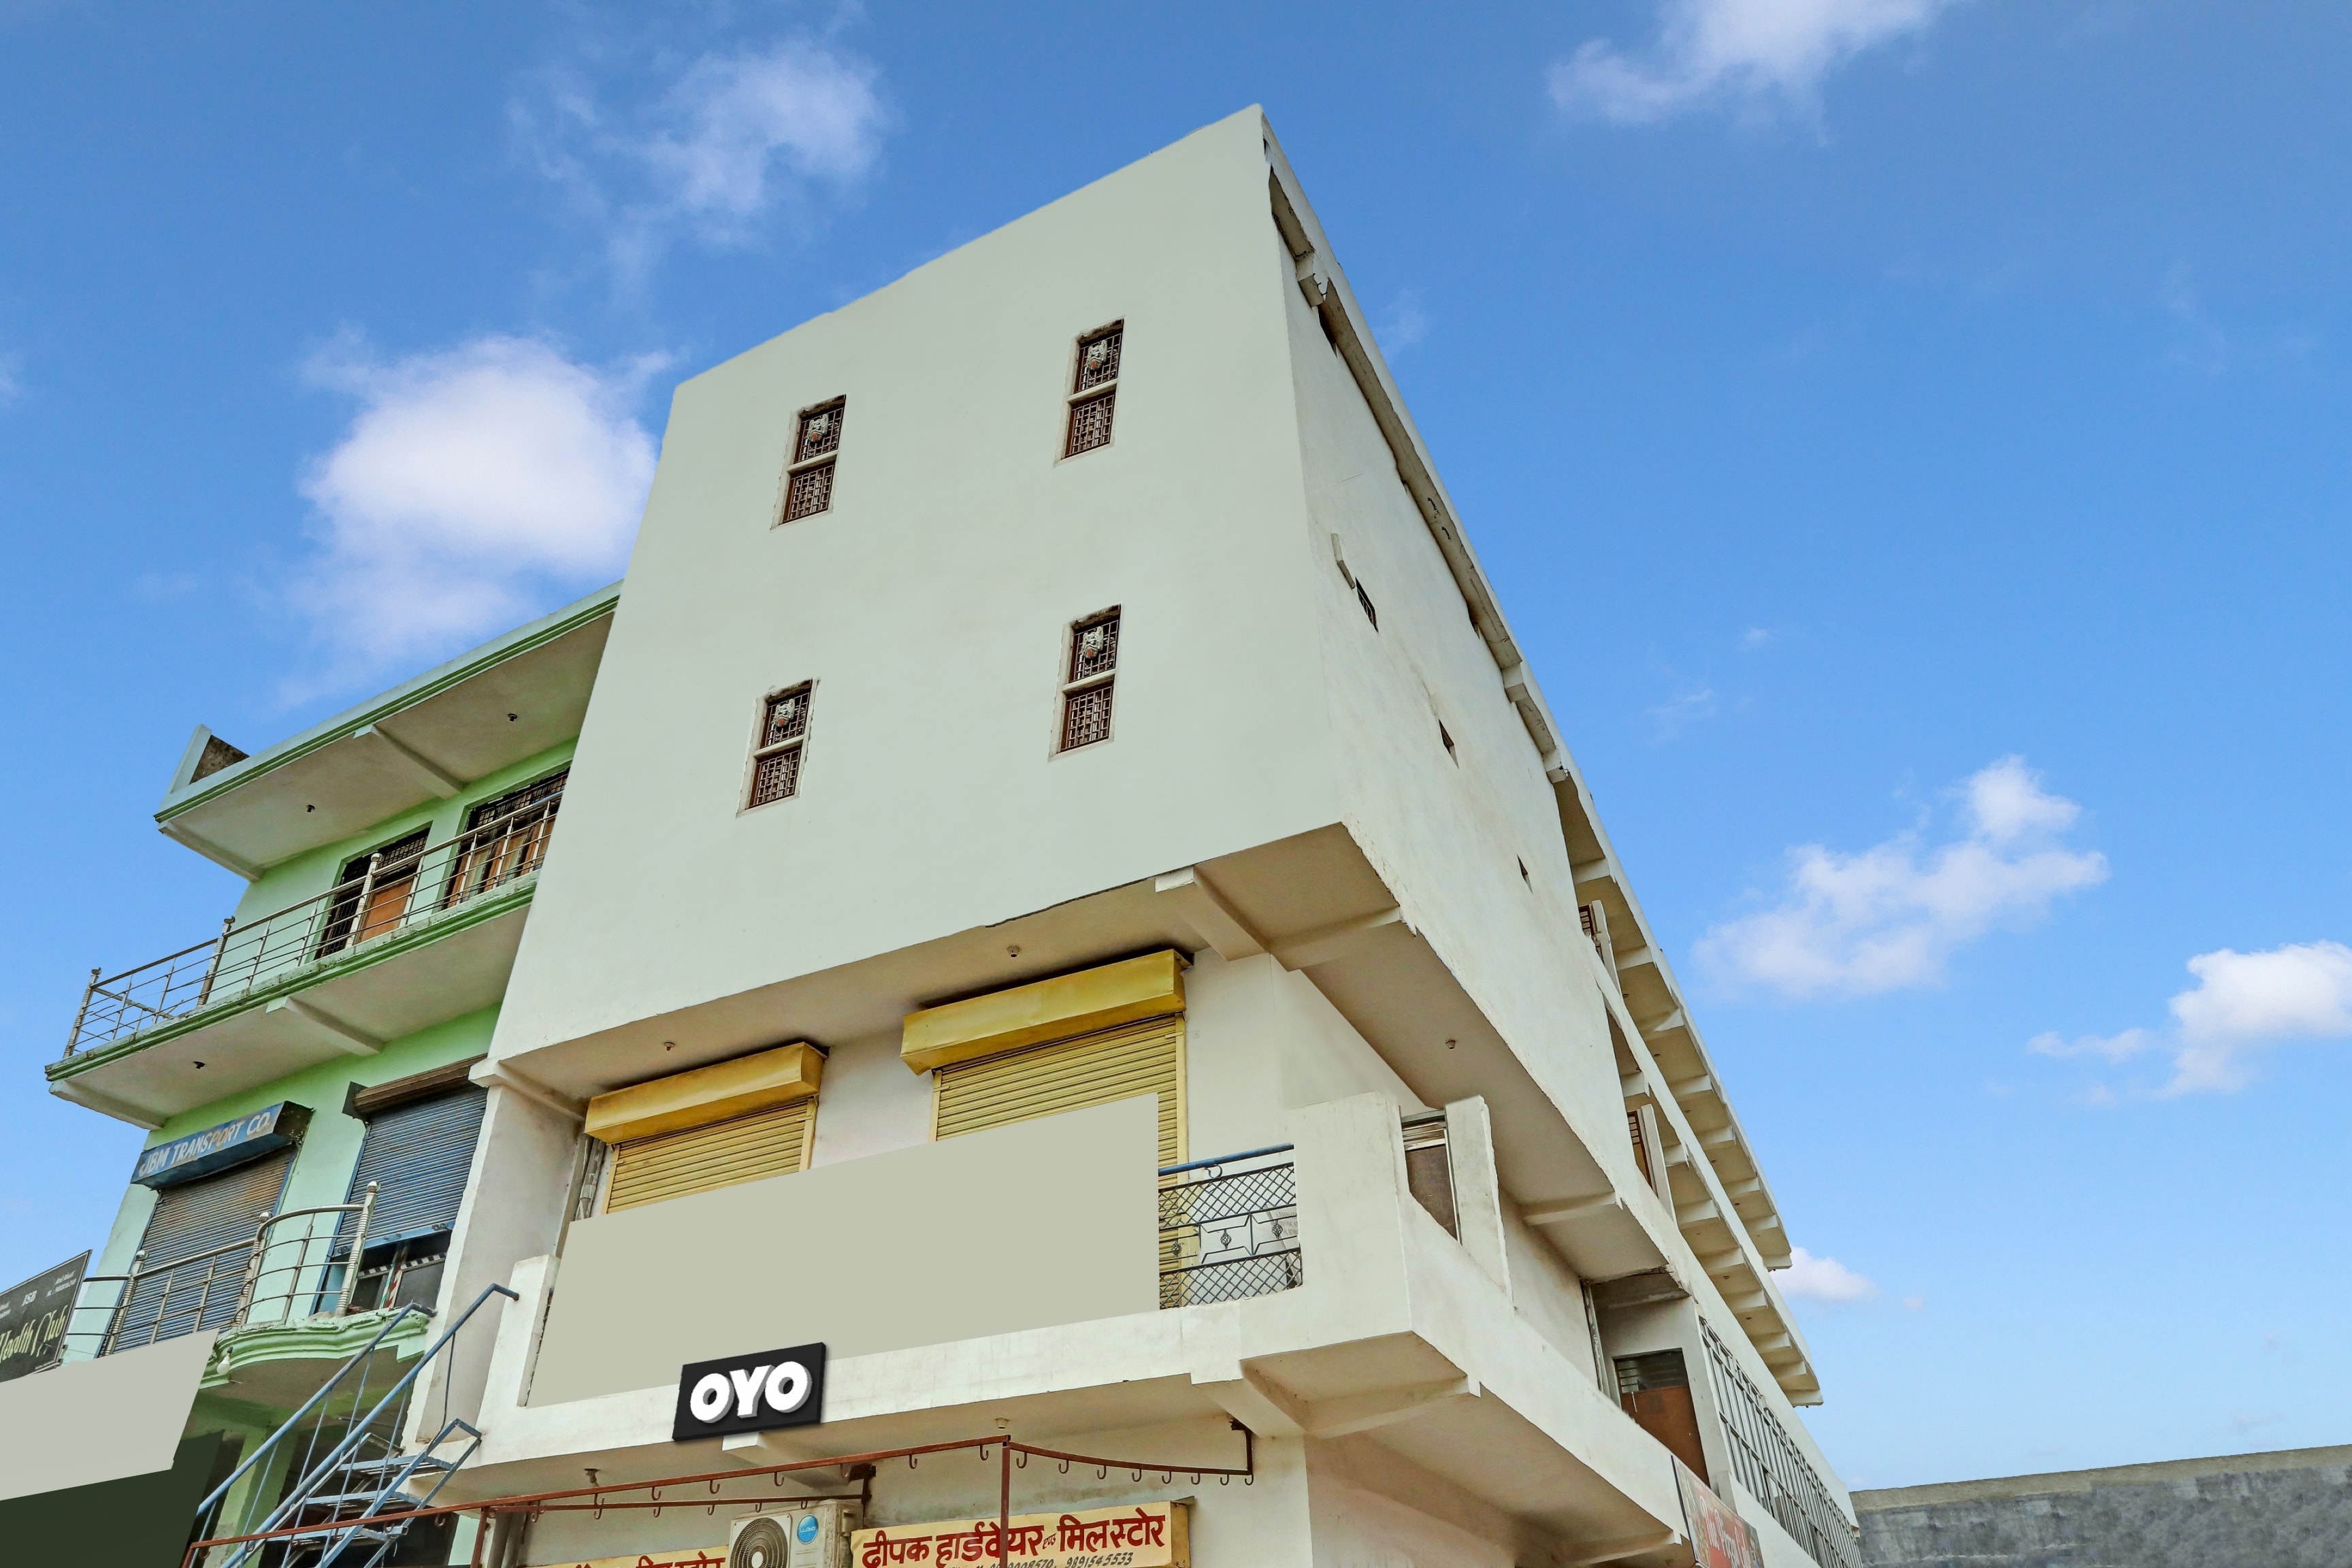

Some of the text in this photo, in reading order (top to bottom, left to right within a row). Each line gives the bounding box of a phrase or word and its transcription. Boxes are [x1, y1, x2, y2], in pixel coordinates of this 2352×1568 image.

[139, 1147, 171, 1177] JBM
[171, 1121, 246, 1164] TRANSPORT
[31, 1305, 68, 1357] Club
[690, 1361, 813, 1424] OYO
[862, 1530, 932, 1568] दीपक
[936, 1521, 1044, 1568] हार्डवेयर
[1057, 1514, 1110, 1553] मिल
[1110, 1507, 1165, 1548] स्टोर
[1065, 1552, 1134, 1568] 9891545533
